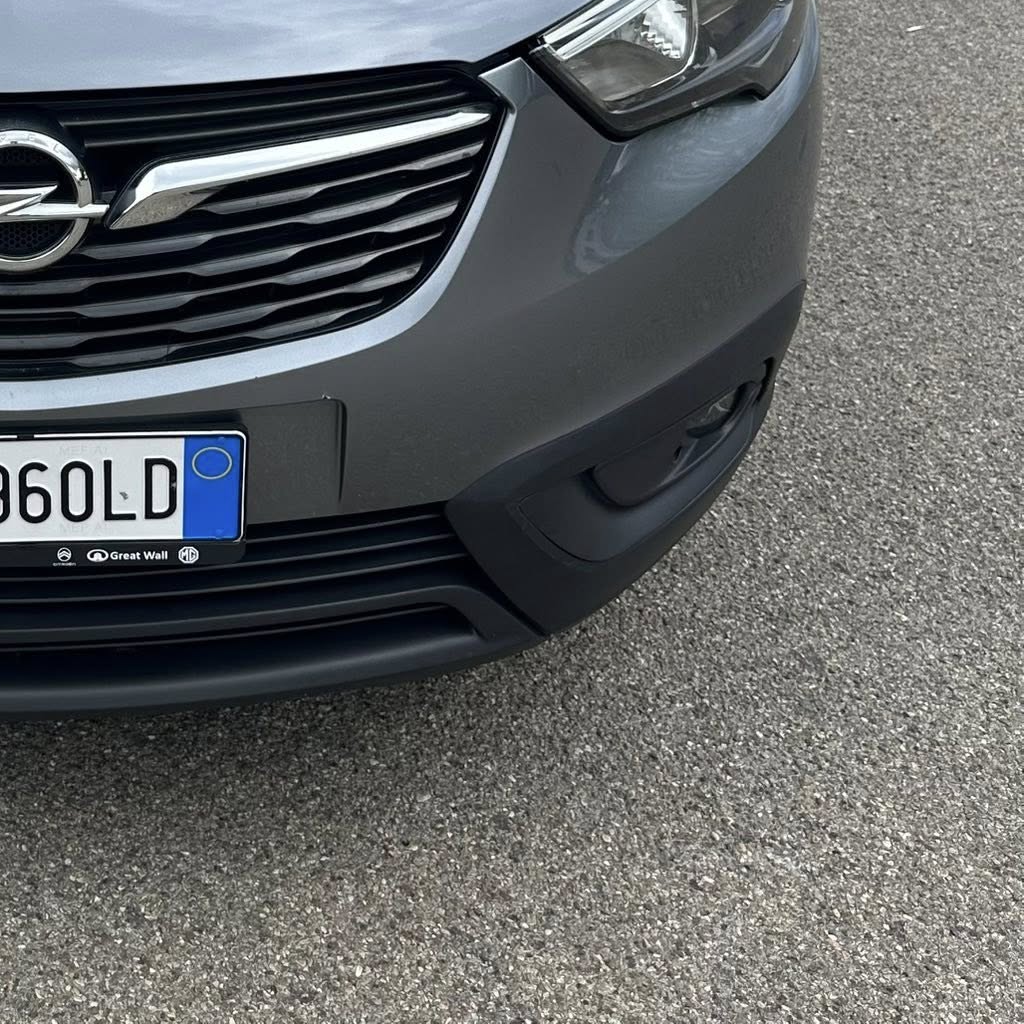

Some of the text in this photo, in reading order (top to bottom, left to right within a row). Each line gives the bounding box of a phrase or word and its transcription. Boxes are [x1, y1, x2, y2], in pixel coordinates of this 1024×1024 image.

[110, 550, 168, 561] Great Wall
[180, 548, 197, 562] MG
